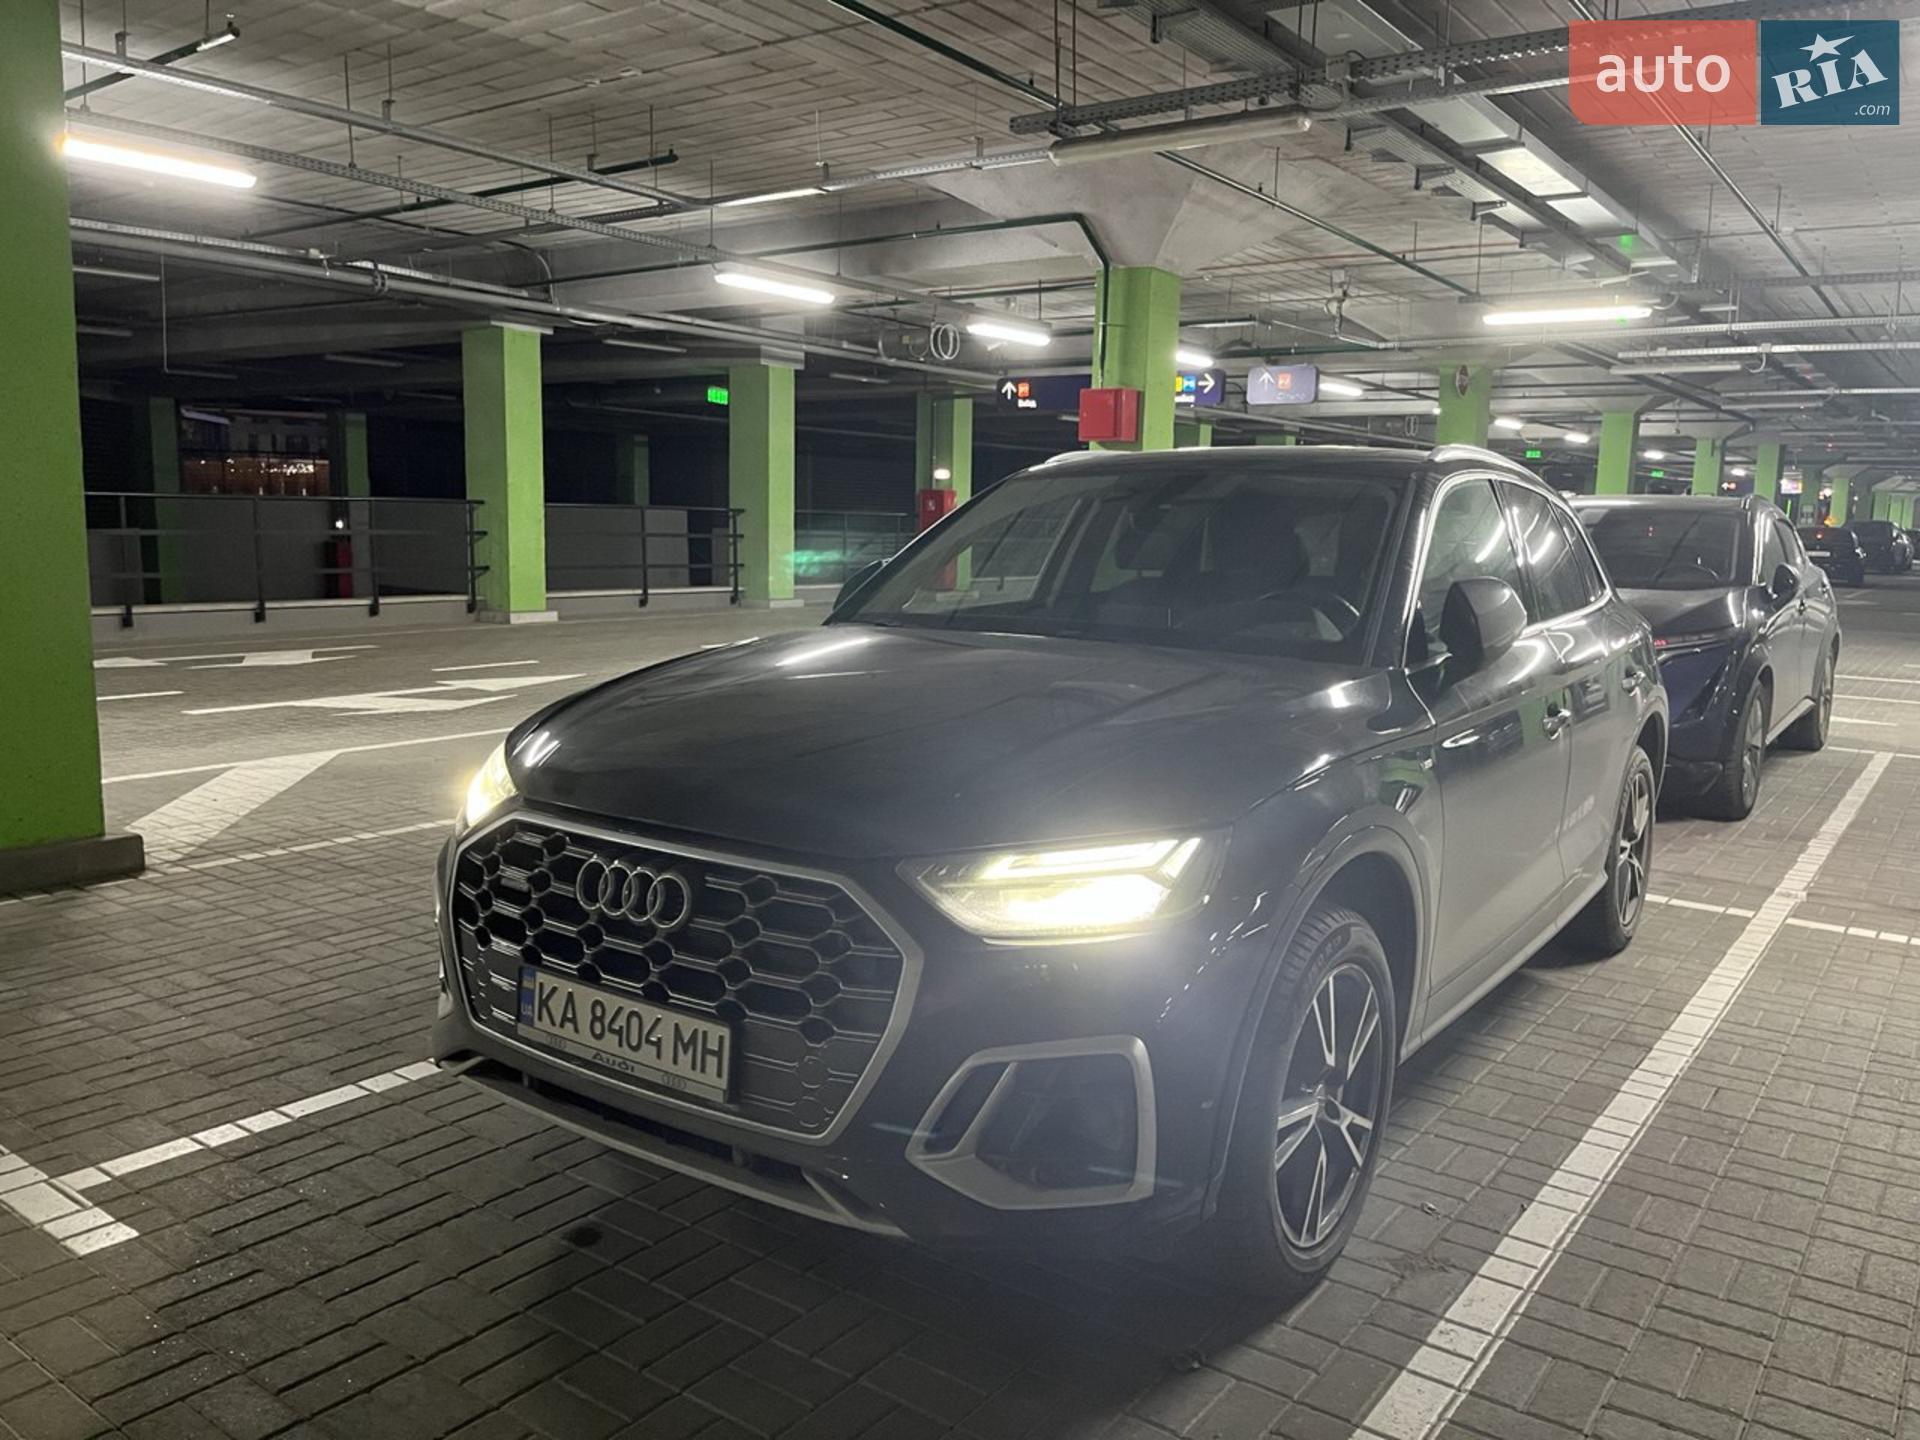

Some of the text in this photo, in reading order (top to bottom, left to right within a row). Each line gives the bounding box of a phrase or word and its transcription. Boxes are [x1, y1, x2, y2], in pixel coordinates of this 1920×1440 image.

[537, 981, 725, 1079] KA 8404 MH
[592, 1052, 635, 1073] Audi
